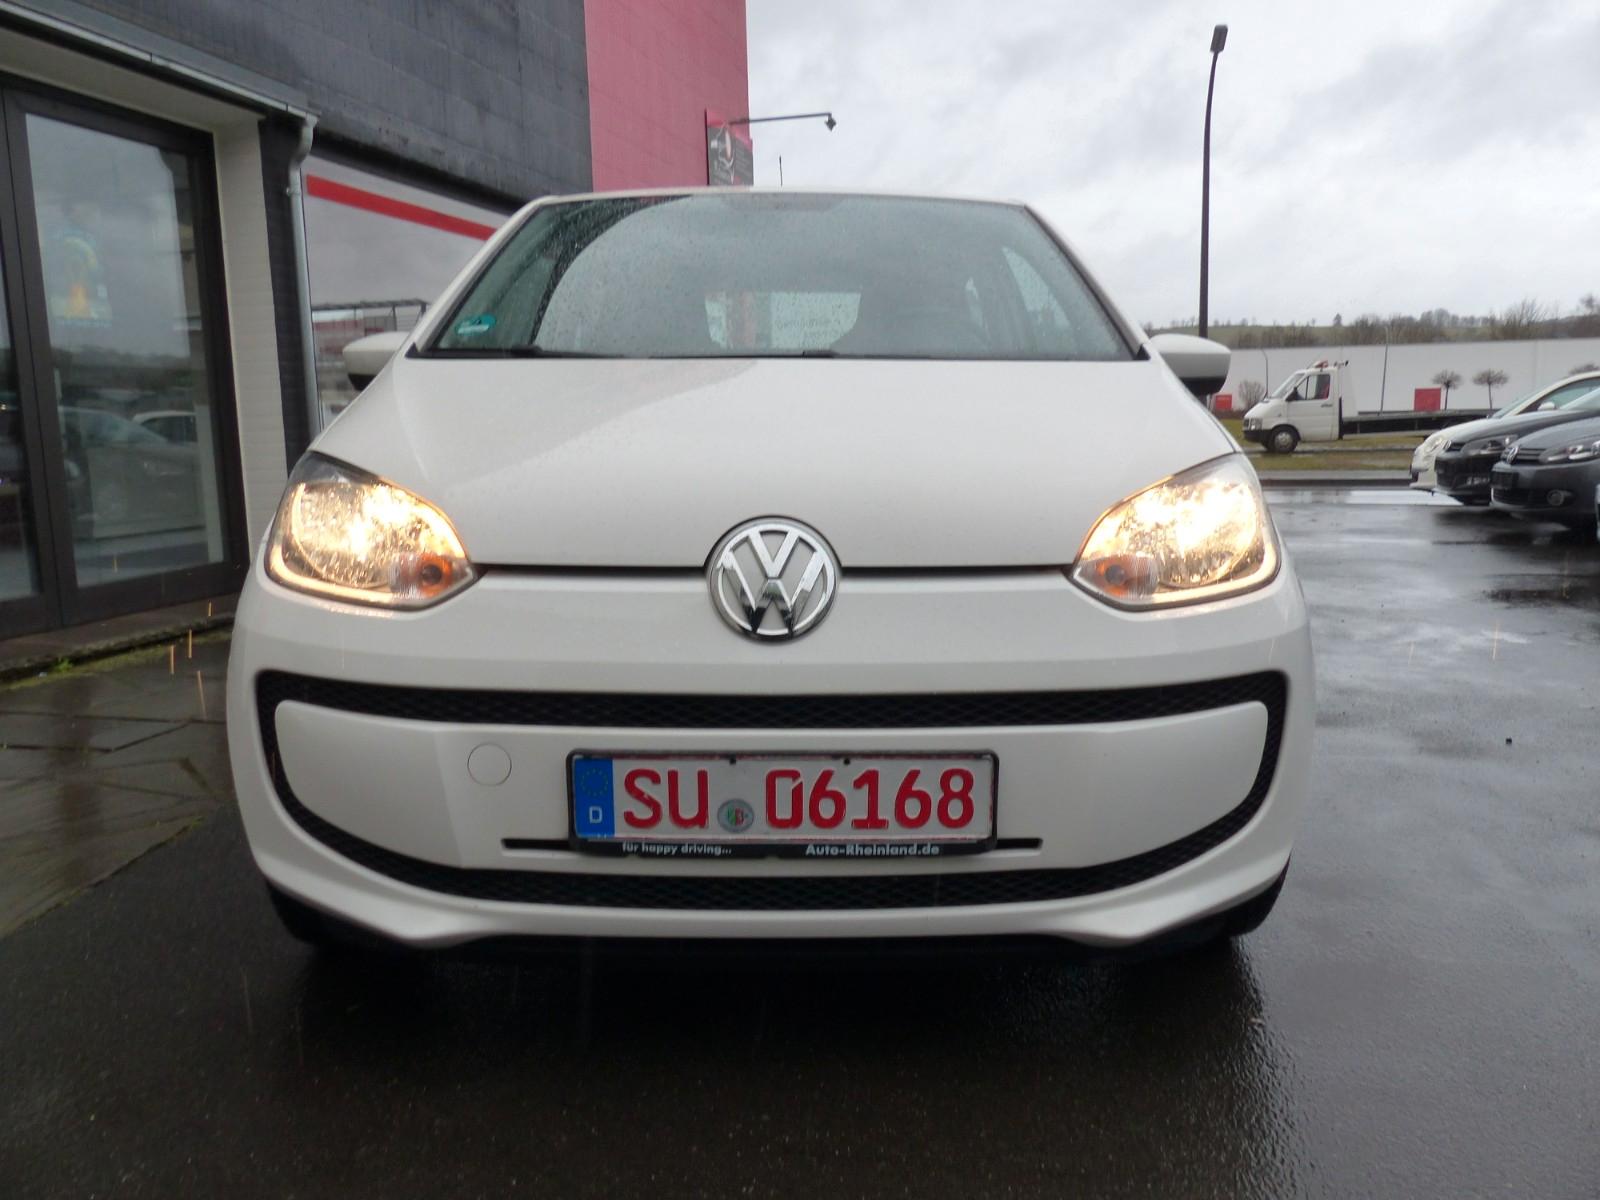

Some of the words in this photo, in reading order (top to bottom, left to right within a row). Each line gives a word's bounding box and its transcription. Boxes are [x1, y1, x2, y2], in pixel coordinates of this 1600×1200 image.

[624, 769, 709, 829] SU
[766, 768, 975, 829] 06168
[589, 806, 602, 823] D
[641, 843, 677, 856] happy
[806, 843, 940, 856] Auto-Rheinland.de
